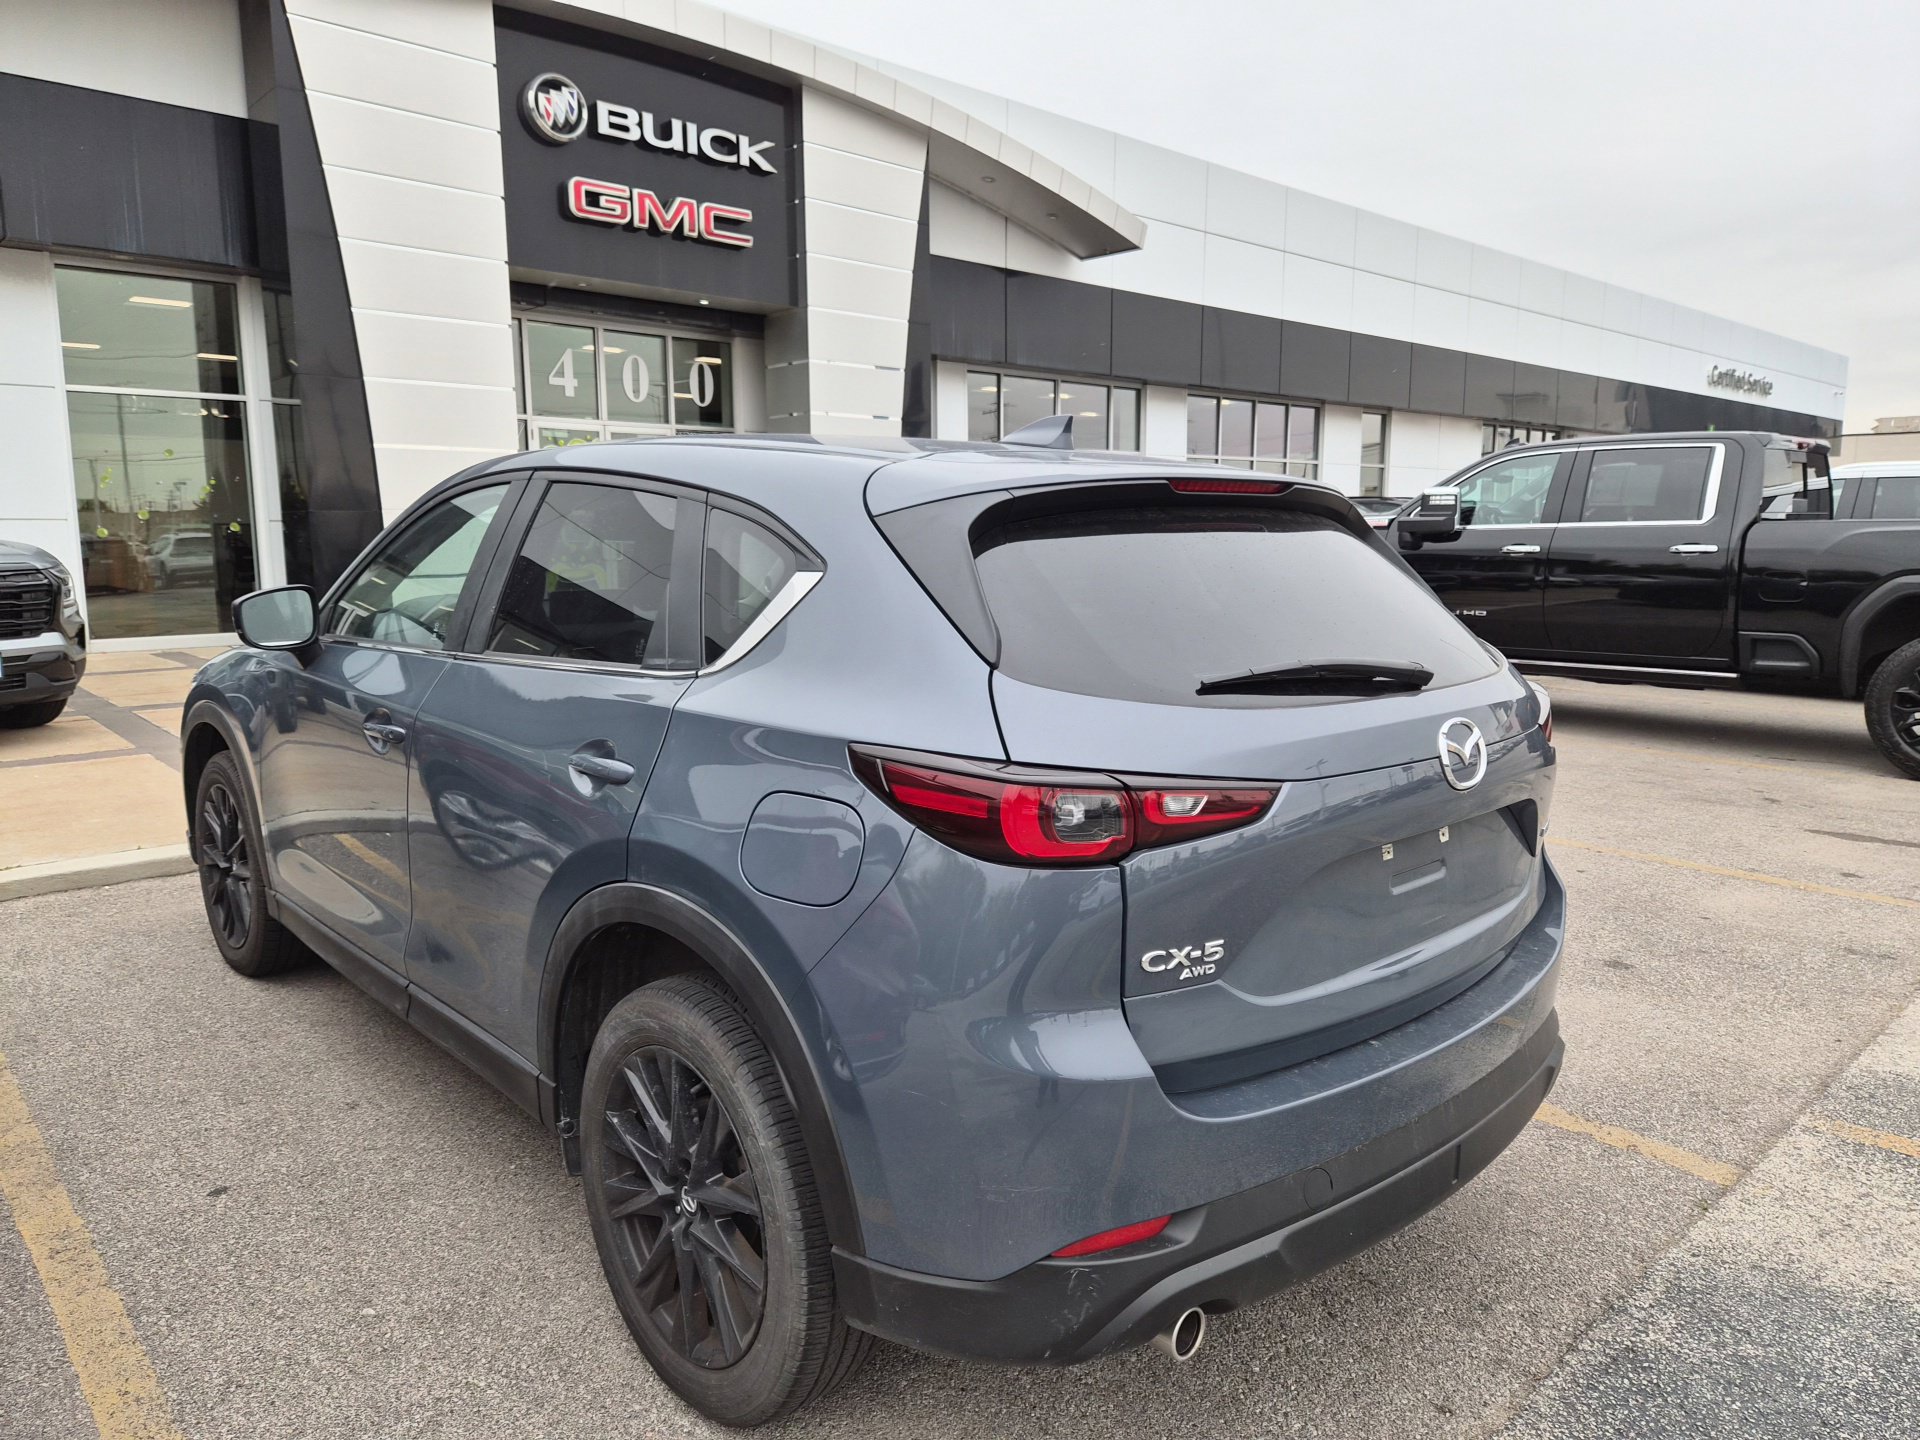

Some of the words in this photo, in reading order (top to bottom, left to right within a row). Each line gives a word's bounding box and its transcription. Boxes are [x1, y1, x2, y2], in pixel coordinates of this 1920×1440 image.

[596, 99, 778, 174] BUICK
[567, 175, 754, 248] GMC
[1141, 939, 1225, 973] CX-5
[1179, 963, 1216, 980] AWD
